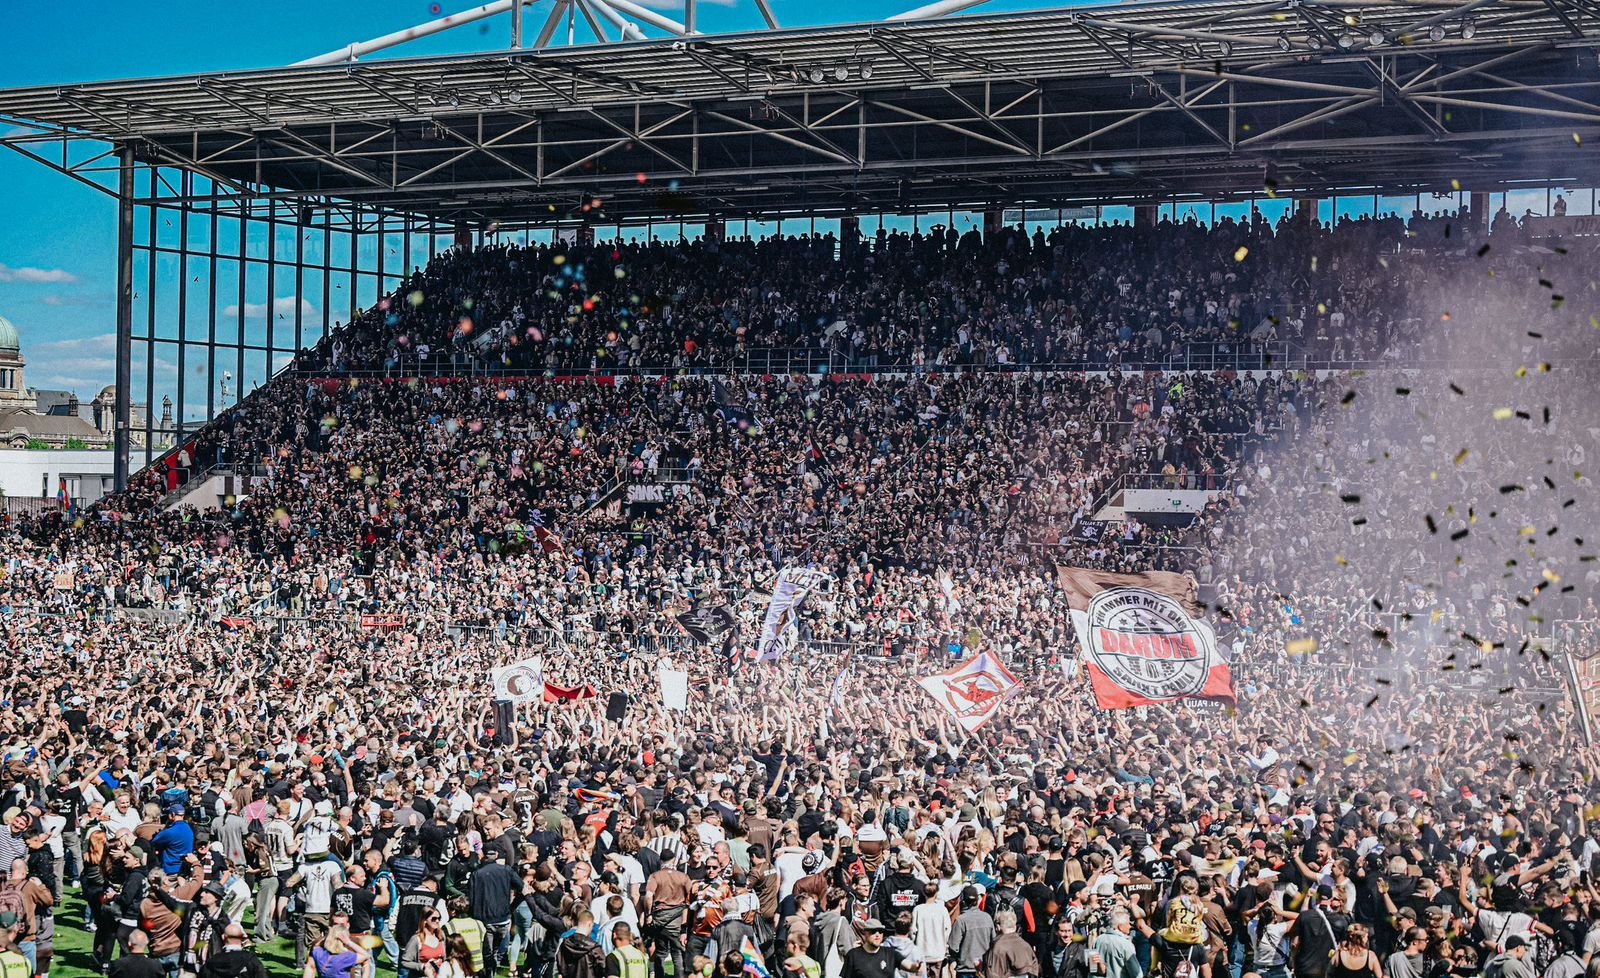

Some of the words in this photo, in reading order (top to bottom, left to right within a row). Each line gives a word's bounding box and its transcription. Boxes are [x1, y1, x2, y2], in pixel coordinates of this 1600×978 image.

[627, 484, 665, 502] SANKT
[1100, 595, 1140, 612] IMMER
[1143, 597, 1167, 613] MIT
[1100, 628, 1198, 659] DARUM
